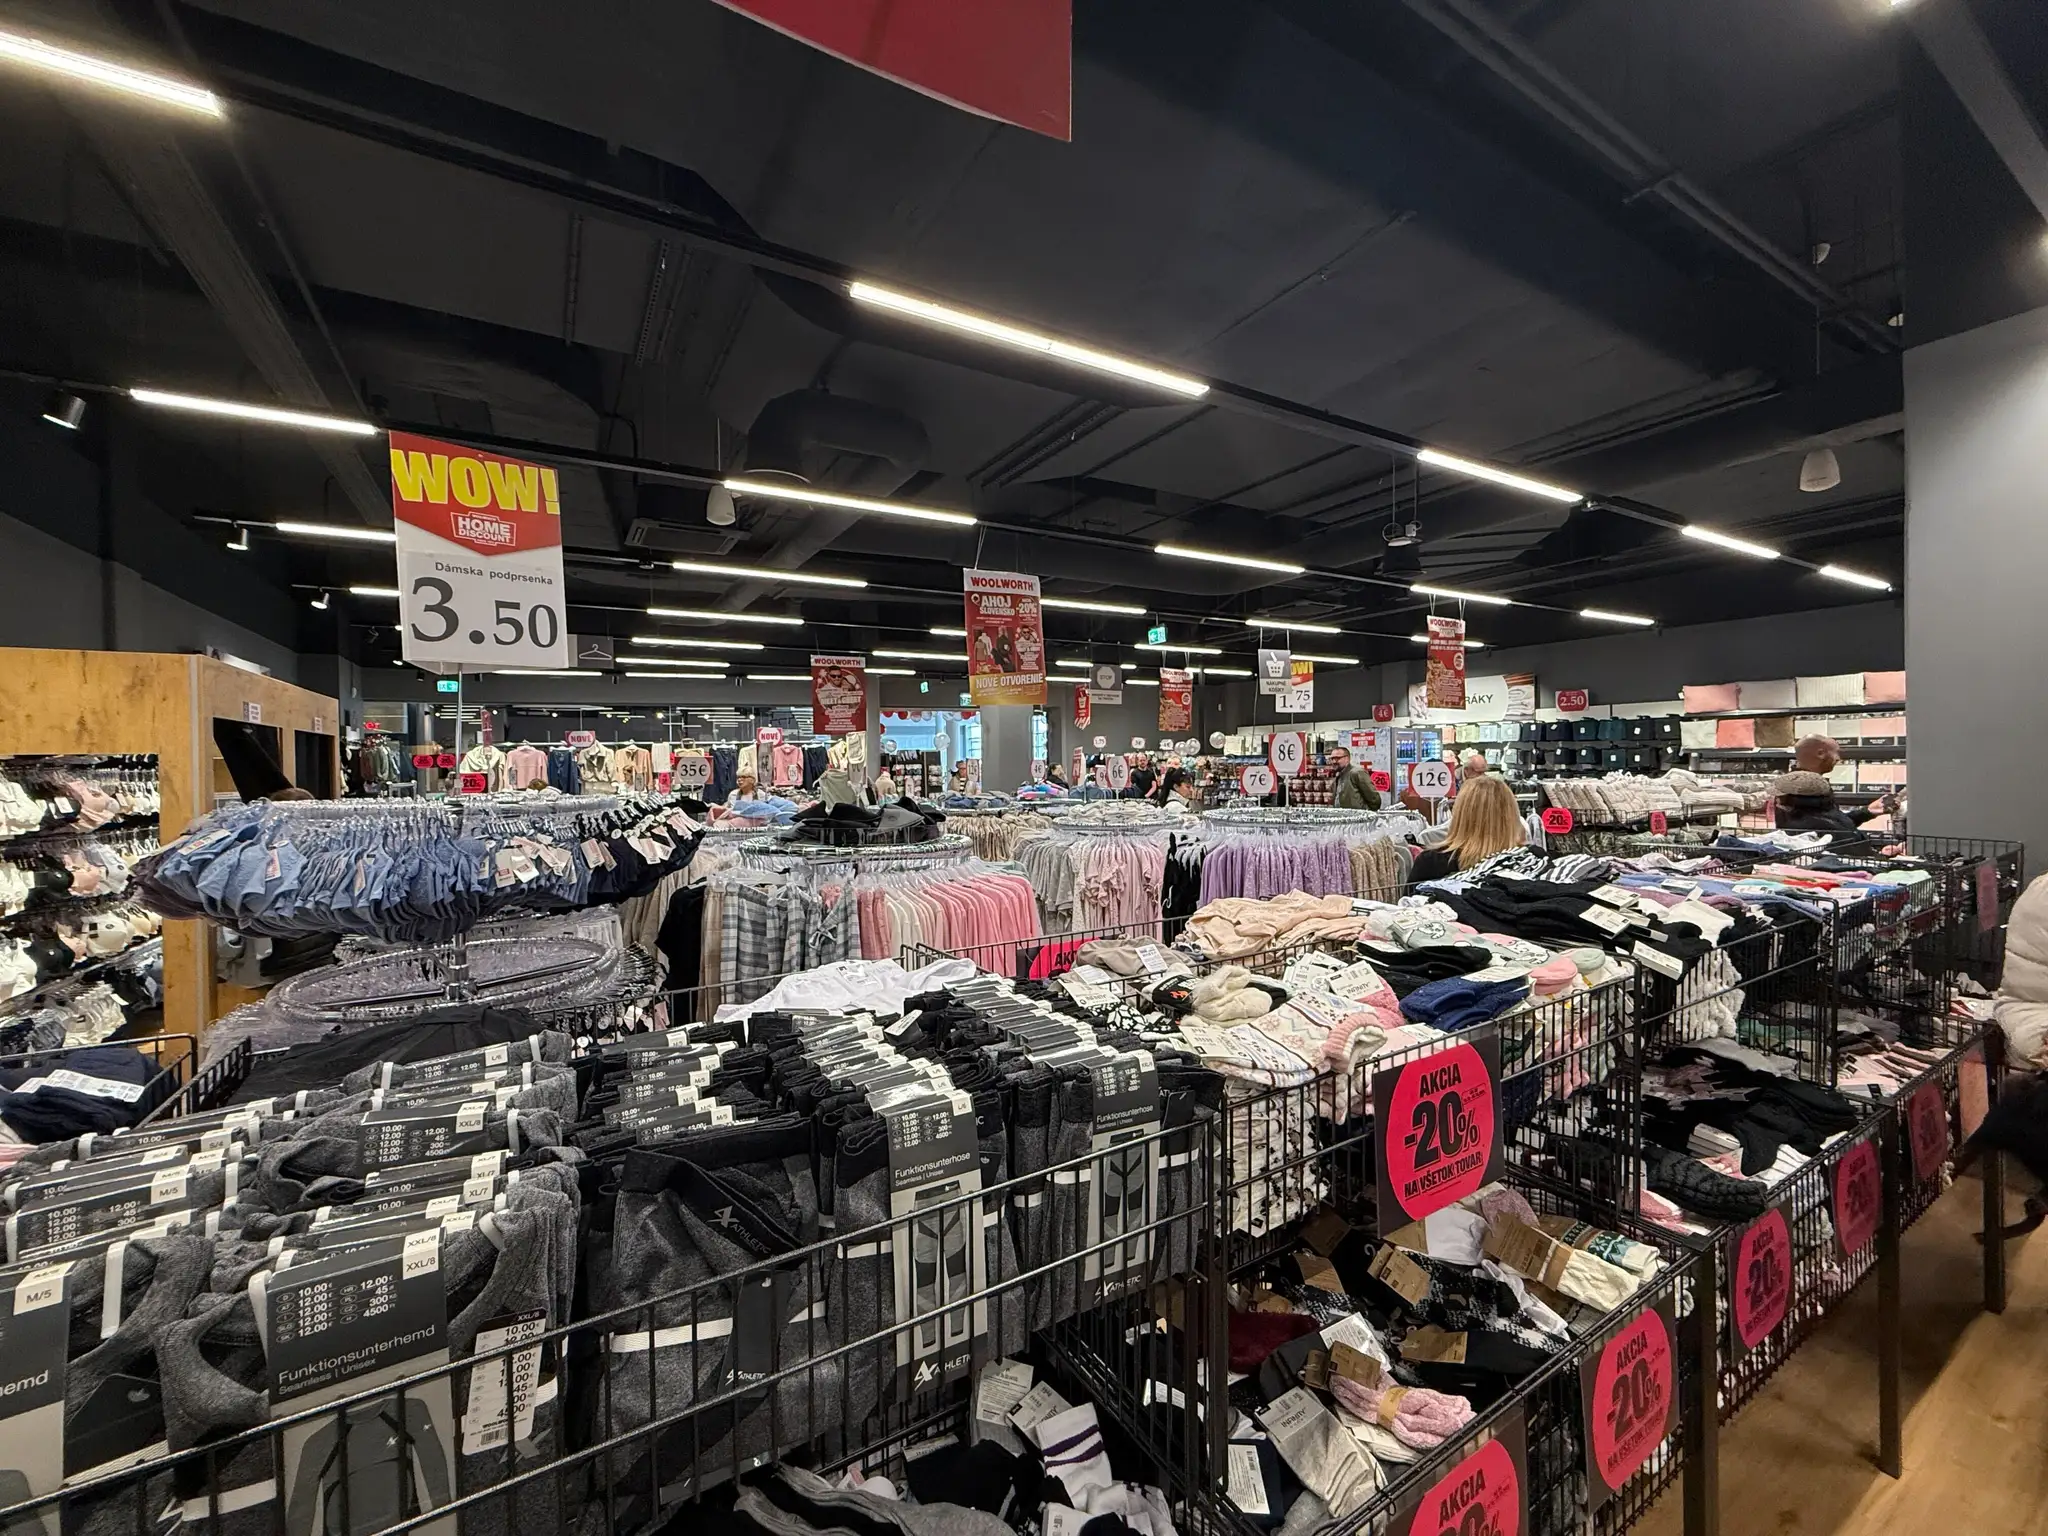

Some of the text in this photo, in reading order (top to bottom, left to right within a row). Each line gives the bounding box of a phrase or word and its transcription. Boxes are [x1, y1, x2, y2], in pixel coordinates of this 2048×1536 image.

[390, 449, 560, 515] WOW!
[457, 516, 511, 537] HOME
[458, 528, 511, 543] DISCOUNT
[435, 562, 553, 586] Dámska podprsenka
[970, 576, 1034, 591] WOOLWORTH
[981, 595, 1011, 607] AHOJ
[411, 576, 558, 648] 3.50
[979, 606, 1015, 616] SLOVENSKO
[814, 658, 861, 666] WOOLWORTH
[976, 673, 1043, 689] NOVÉ OTVORENIE
[1560, 696, 1584, 706] 2.50
[1278, 744, 1296, 762] 8€
[680, 764, 708, 777] 35€
[1112, 765, 1124, 778] 6€
[1249, 773, 1267, 786] 7€
[1416, 771, 1447, 787] 12€
[1419, 1063, 1462, 1098] AKCIA
[458, 1119, 481, 1128] XXL/8
[1404, 1090, 1480, 1172] -20%
[894, 1152, 971, 1179] Funktionsunterhose
[1404, 1151, 1483, 1200] NA VŠETOK TOVAR
[159, 1187, 179, 1197] M/5
[469, 1187, 488, 1197] XL/7
[406, 1235, 437, 1248] XXL/8
[730, 1223, 773, 1254] ATHLETIC
[405, 1257, 436, 1272] XXL/8
[26, 1289, 53, 1304] M/5
[278, 1325, 436, 1385] Funktionsunterhemd
[1616, 1330, 1648, 1374] AKCIA
[279, 1358, 377, 1395] Seamless Unisex
[1606, 1357, 1661, 1443] -20%
[1438, 1468, 1486, 1529] AKCIA
